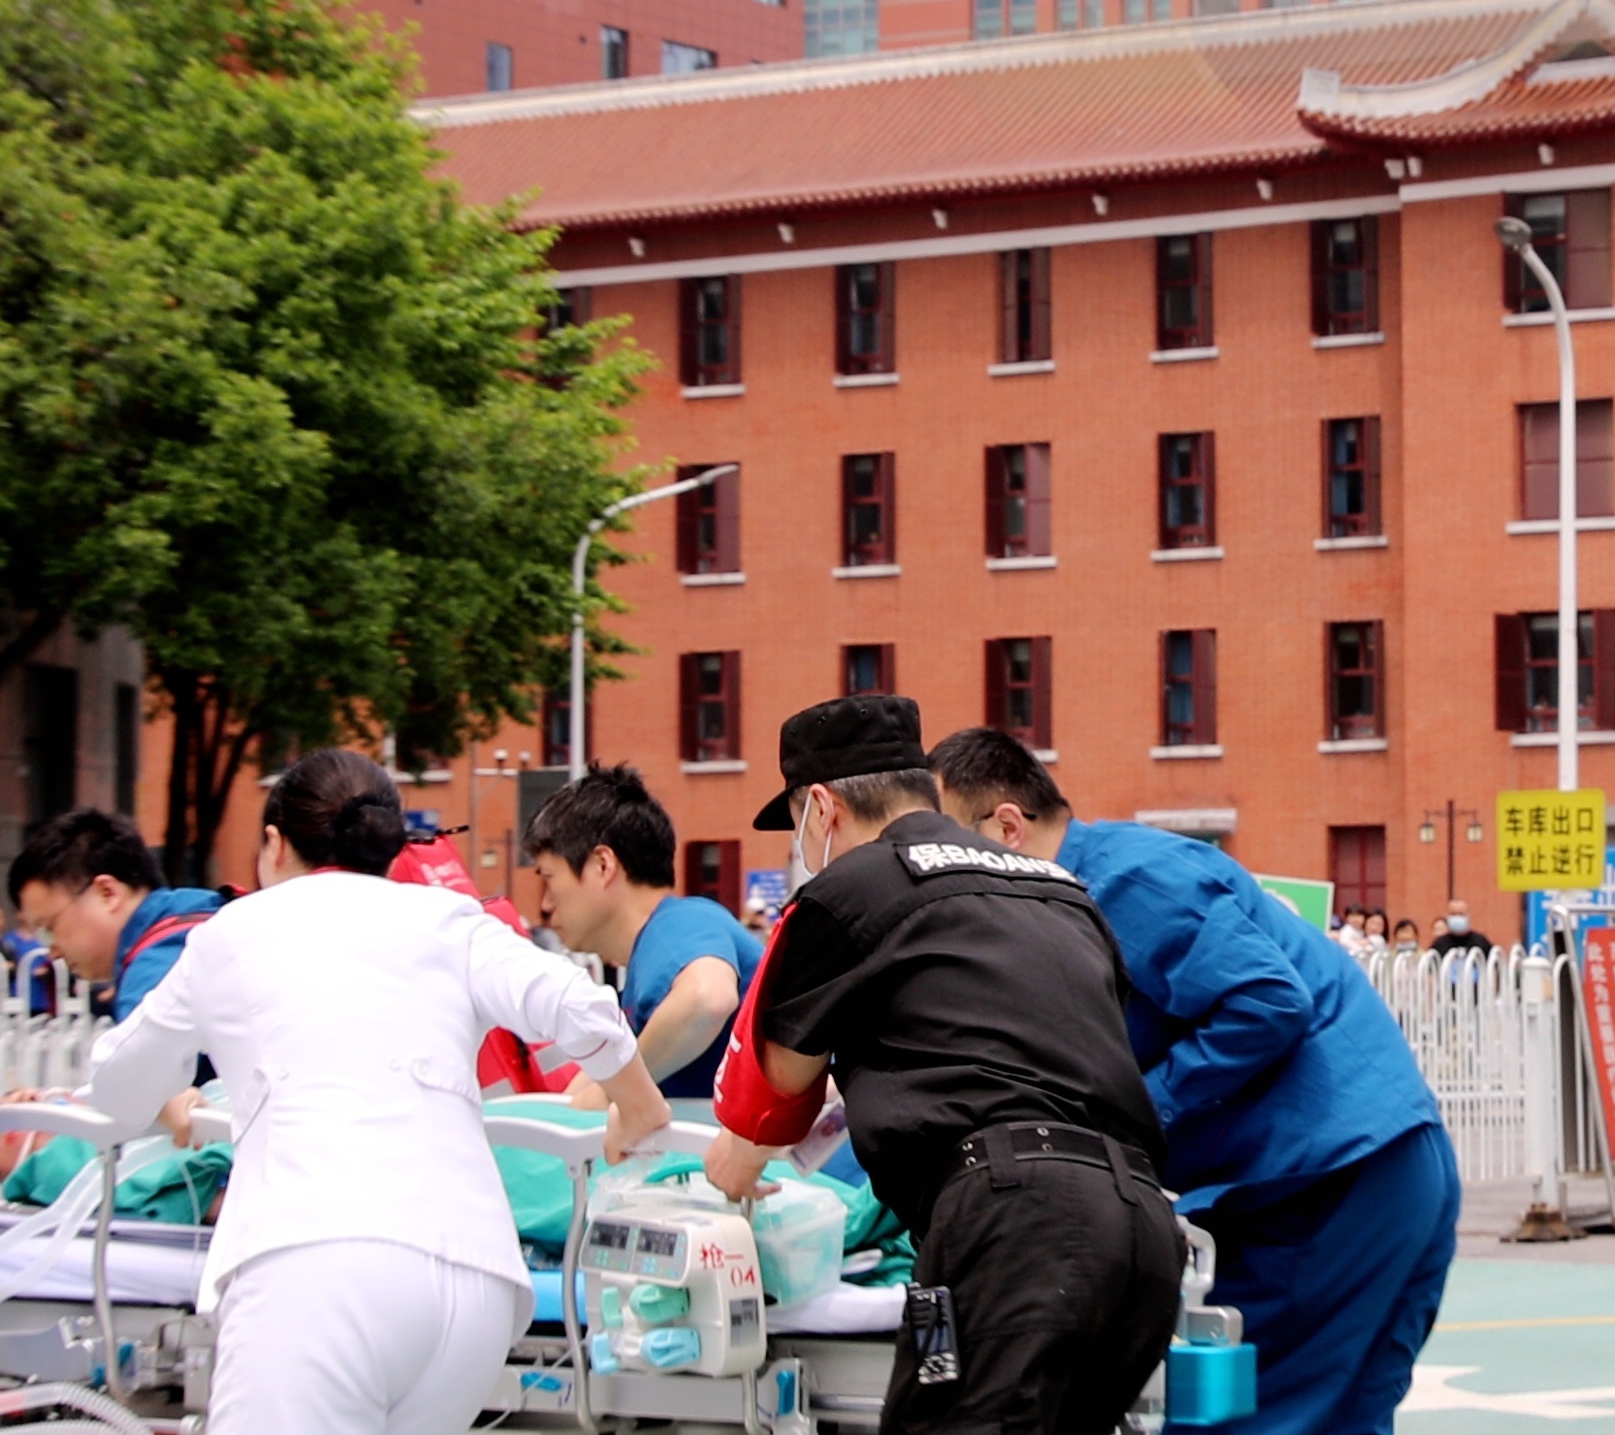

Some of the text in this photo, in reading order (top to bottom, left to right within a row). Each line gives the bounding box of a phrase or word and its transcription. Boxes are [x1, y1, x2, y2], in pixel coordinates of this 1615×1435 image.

[1505, 805, 1594, 836] 车库出口
[1507, 845, 1595, 876] 禁止逆行
